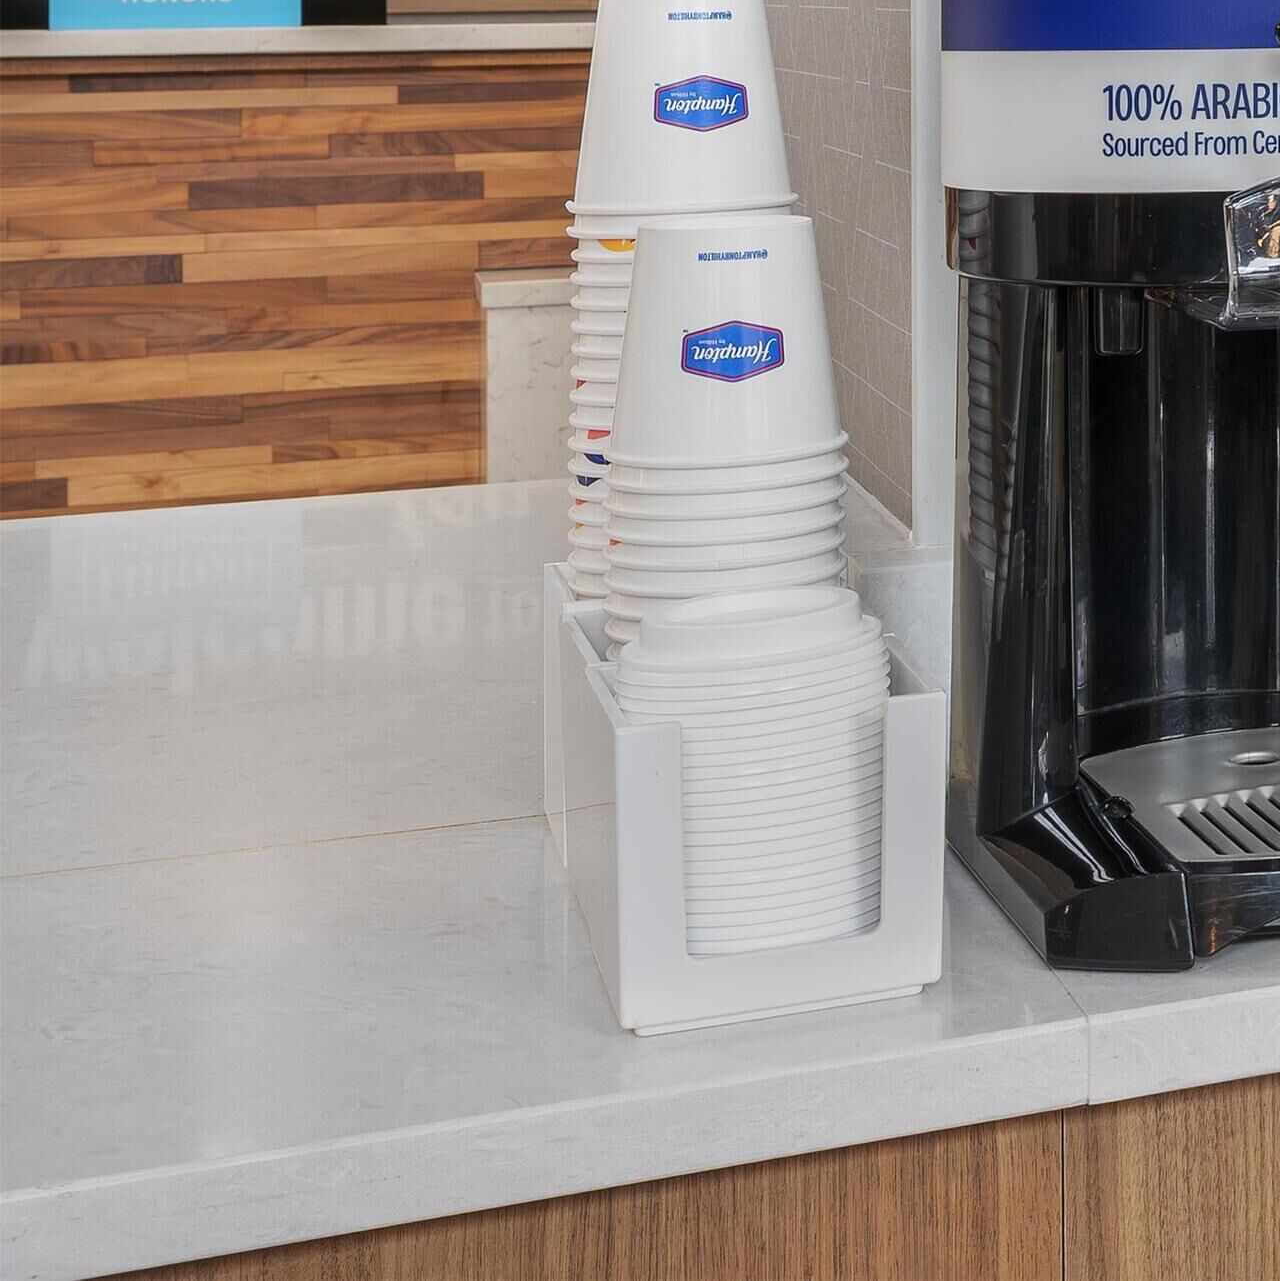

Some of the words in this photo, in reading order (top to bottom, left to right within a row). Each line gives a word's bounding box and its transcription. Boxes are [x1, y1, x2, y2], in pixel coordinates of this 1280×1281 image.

[663, 93, 741, 116] Hampton
[1102, 83, 1182, 121] 100%
[1102, 131, 1189, 158] Sourced
[1195, 130, 1248, 156] From
[691, 337, 777, 364] Hampton
